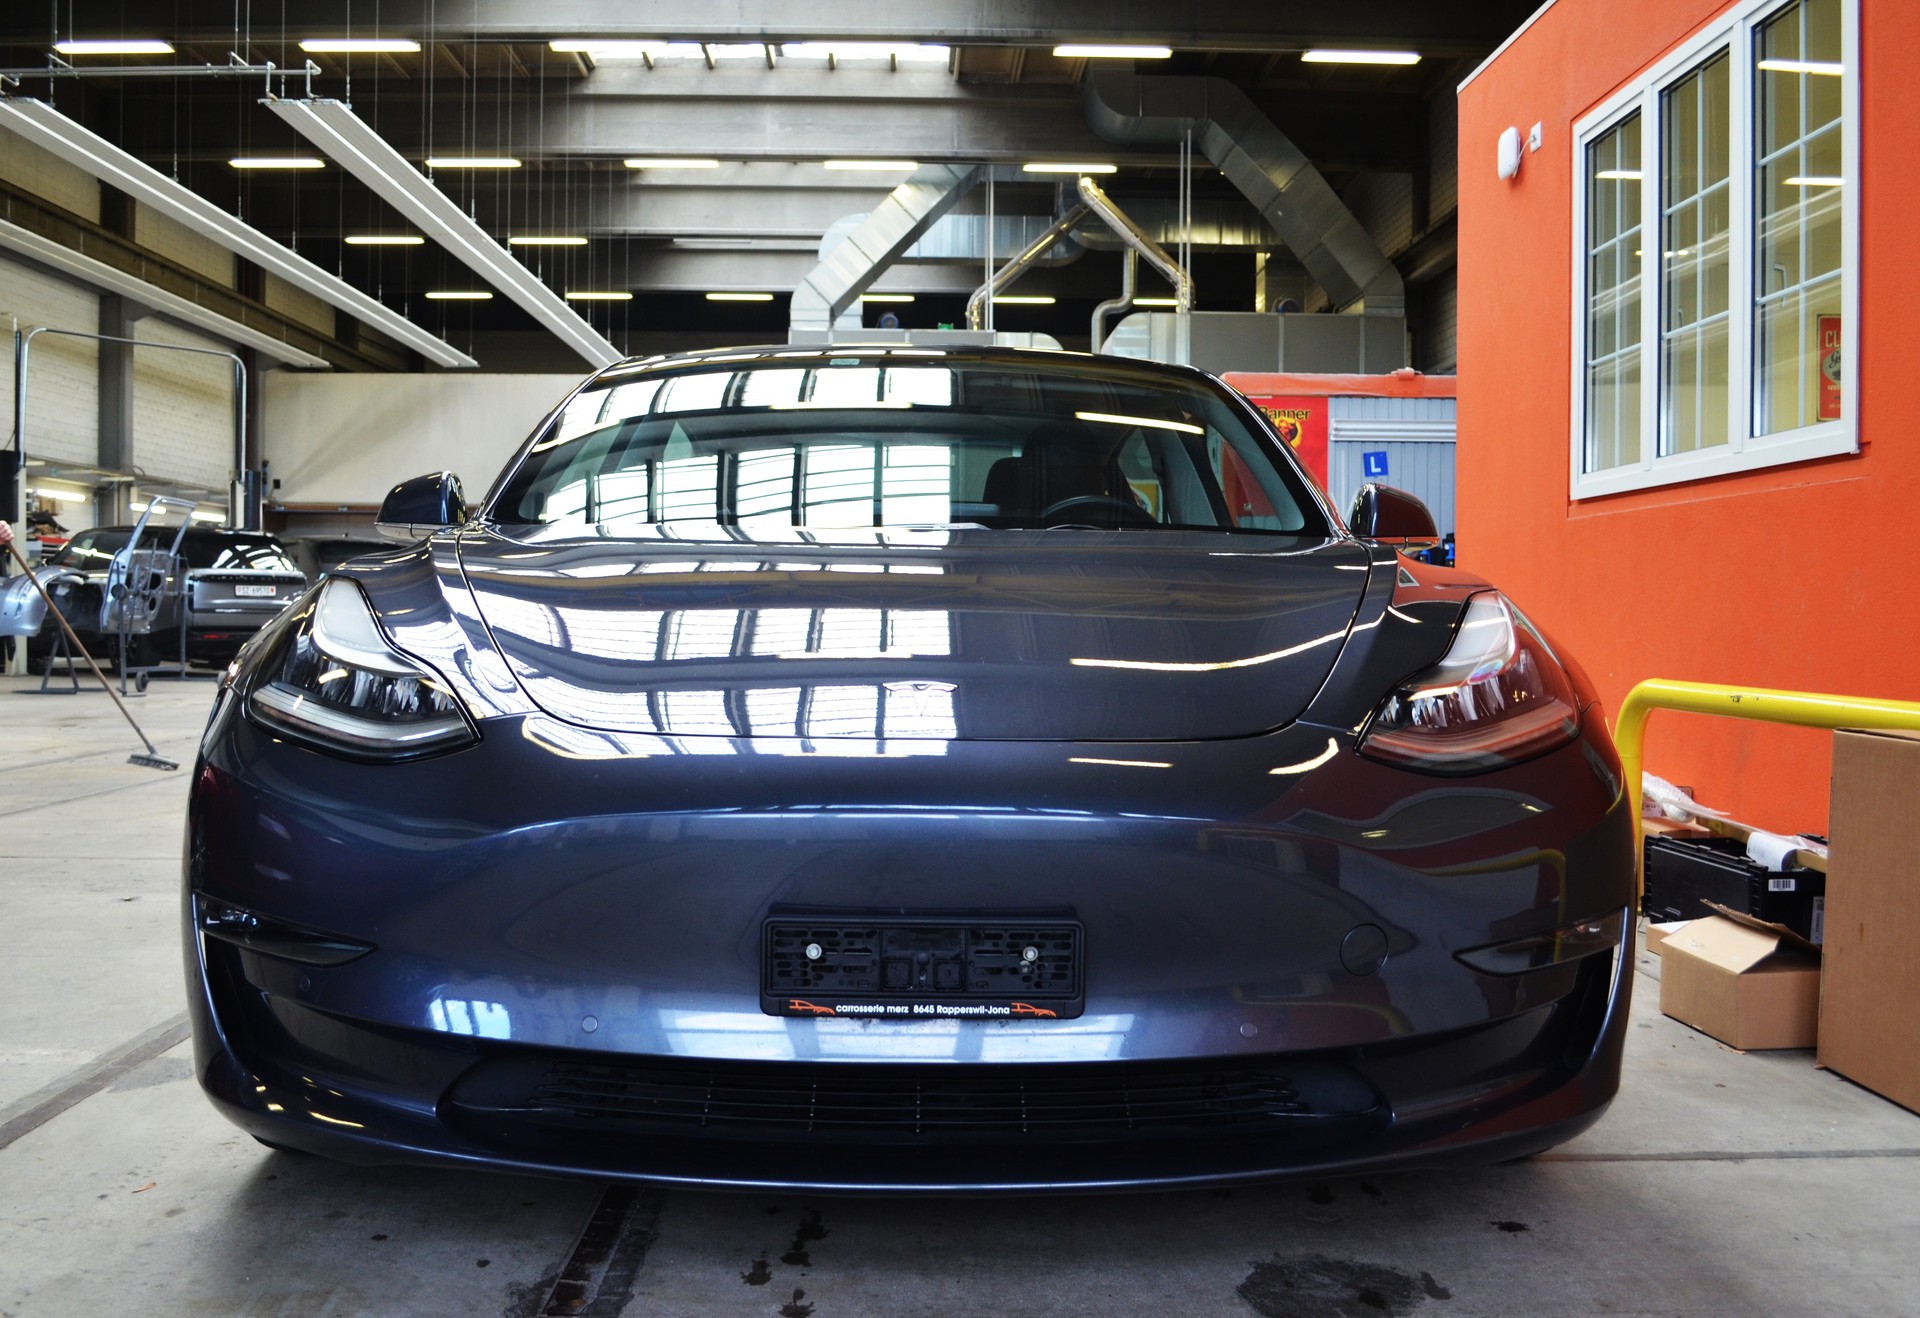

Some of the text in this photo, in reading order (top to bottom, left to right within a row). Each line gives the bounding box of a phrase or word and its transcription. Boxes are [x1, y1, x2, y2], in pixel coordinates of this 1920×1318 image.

[1370, 457, 1381, 473] L
[836, 1004, 1010, 1015] carrosserie merz 8645 Rapperswil-Jona
